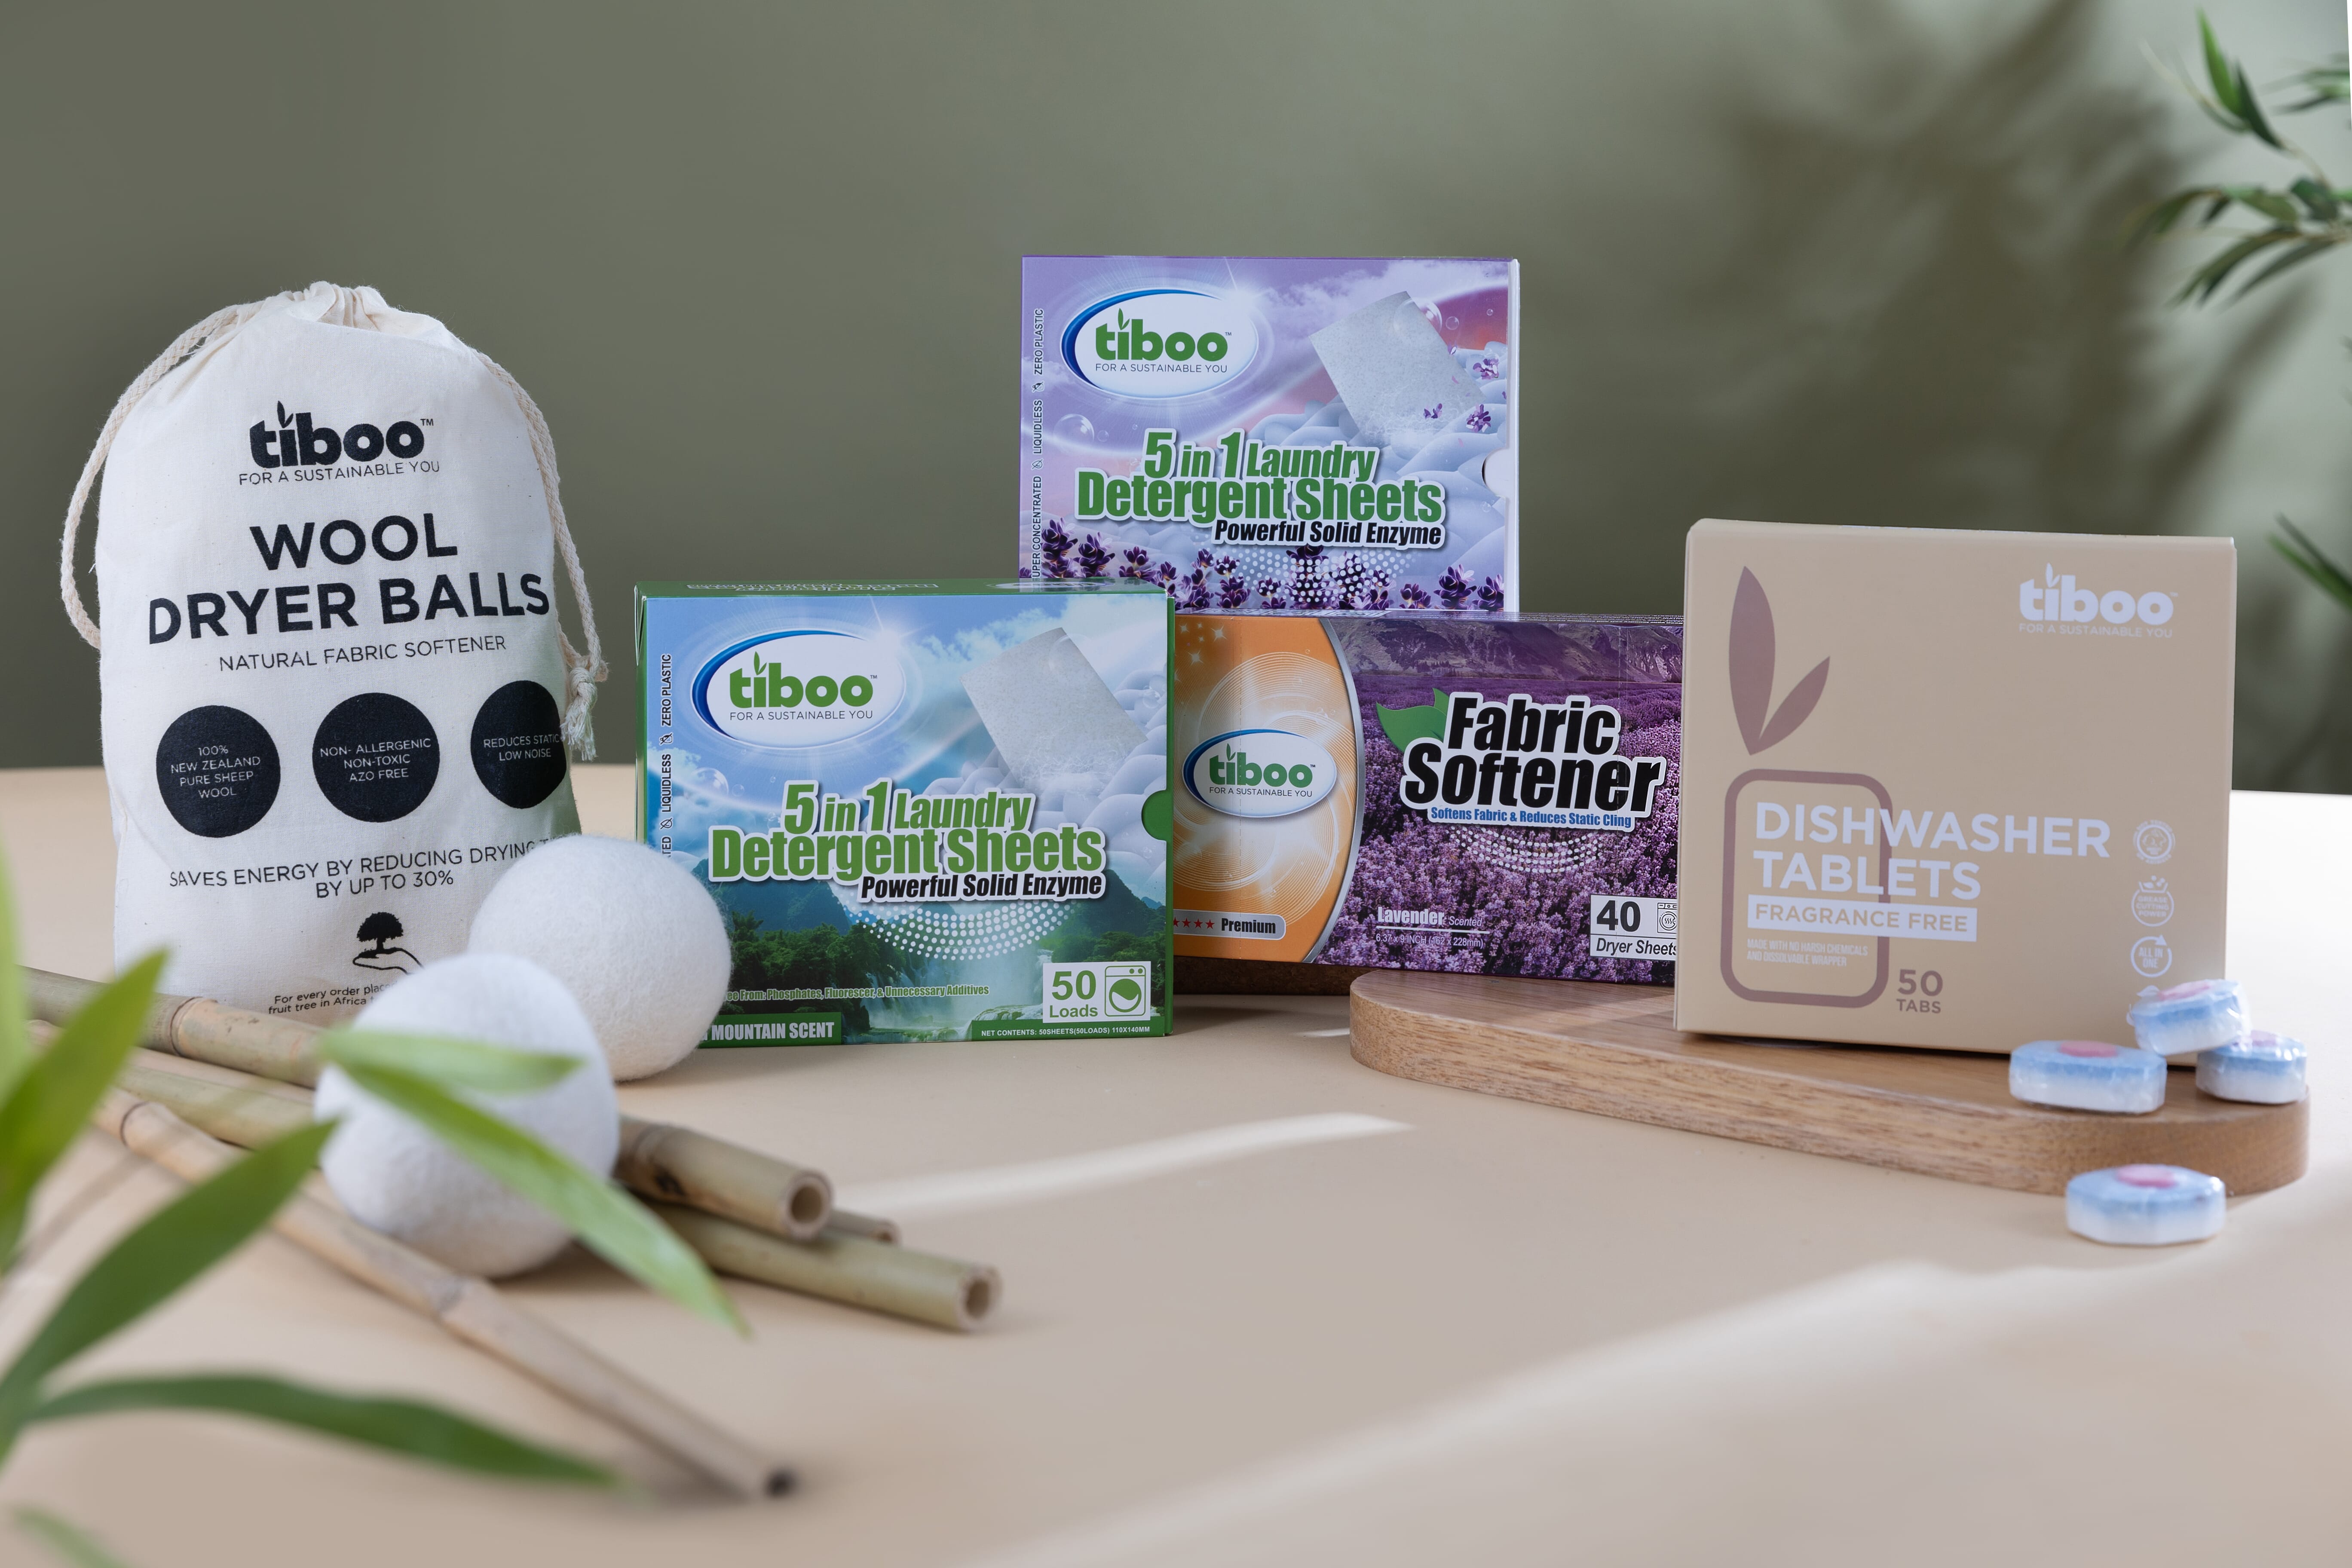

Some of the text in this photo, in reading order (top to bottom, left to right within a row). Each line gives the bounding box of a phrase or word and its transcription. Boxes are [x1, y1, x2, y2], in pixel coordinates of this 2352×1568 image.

[1034, 309, 1043, 375] ZERO PLASTIC
[1096, 318, 1228, 361] tiboo
[1130, 364, 1202, 372] SUSTAINABLE
[1033, 400, 1042, 454] LIQUIDLESS
[249, 412, 425, 469] tiboo
[1144, 432, 1376, 481] 5 in 1 Laundry
[239, 461, 440, 485] FOR A SUSTAINABLE YOU
[1078, 472, 1442, 523] Detergent Sheets
[1032, 476, 1041, 577] UPER CONCENTRATED
[1215, 520, 1442, 545] Powerful Solid Enzyme
[250, 513, 458, 571] WOOL
[149, 572, 550, 645] DRYER BALLS
[2020, 575, 2173, 625] tiboo
[2020, 624, 2172, 637] FOR A SUSTAINABLE YOU
[219, 635, 506, 671] NATURAL FABRIC SOFTENER
[662, 655, 671, 726] ZERO PLASTIC
[729, 663, 874, 708] tiboo
[730, 712, 753, 720] FOR
[768, 711, 845, 720] SUSTAINABLE
[849, 710, 873, 719] YOU
[1448, 697, 1615, 755] Fabric
[198, 745, 229, 756] 100%
[320, 738, 431, 757] NON- ALLERGENIC
[484, 734, 560, 748] REDUCES STATIC
[171, 756, 260, 774] NEW ZEALAND
[344, 754, 411, 769] NON-TOXIC
[499, 748, 551, 761] LOW NOISE
[180, 771, 254, 787] PURE SHEEP
[349, 768, 409, 782] AZO FREE
[1210, 752, 1313, 788] tiboo
[1405, 743, 1661, 812] Softener
[198, 787, 237, 799] WOOL
[662, 754, 671, 812] LIQUIDLESS
[1237, 788, 1292, 796] SUSTAINABLE
[784, 782, 1032, 834] 5 in 1 Laundry
[1431, 807, 1631, 828] Softens Fabric & Reduces Static Cling
[1756, 802, 2111, 858] DISHWASHER
[713, 828, 938, 881] Detergent
[946, 827, 1102, 874] Sheets
[169, 871, 227, 886] SAVES
[234, 863, 318, 885] ENERGY
[327, 860, 353, 877] BY
[361, 849, 462, 873] REDUCING
[1753, 851, 1981, 900] TABLETS
[316, 870, 454, 898] BY UP TO 30%
[862, 873, 1102, 899] Powerful Solid Enzyme
[1222, 918, 1276, 934] Premium
[1378, 906, 1482, 927] Lavender Scented
[1597, 900, 1641, 932] 40
[1755, 904, 1967, 932] FRAGRANCE FREE
[1376, 934, 1391, 942] 6.37
[1429, 936, 1445, 945] (162
[1453, 937, 1483, 948] 228mm)
[1596, 937, 1632, 956] Dryer
[1747, 938, 1868, 956] MADE WITH NO HARSH CHEMICALS
[2139, 947, 2163, 958] ALL IN
[1747, 951, 1847, 966] AND DISSOLVABLE WRAPPER
[2143, 958, 2158, 968] ONE
[740, 990, 766, 1001] From:
[767, 989, 824, 1001] Phosphates,
[824, 987, 876, 999] Fluorescer,
[876, 988, 884, 998] &
[885, 985, 946, 998] Unnecessary
[946, 984, 989, 995] Additives
[1052, 971, 1096, 1001] 50
[1898, 969, 1943, 997] 50
[268, 1006, 291, 1014] fruit
[295, 1002, 317, 1011] tree
[334, 996, 366, 1005] Africa
[274, 995, 293, 1004] For
[297, 990, 327, 1001] every
[330, 987, 360, 996] order
[1896, 998, 1941, 1014] TABS
[1050, 1004, 1098, 1018] Loads
[711, 1023, 786, 1041] MOUNTAIN
[789, 1022, 835, 1039] SCENT
